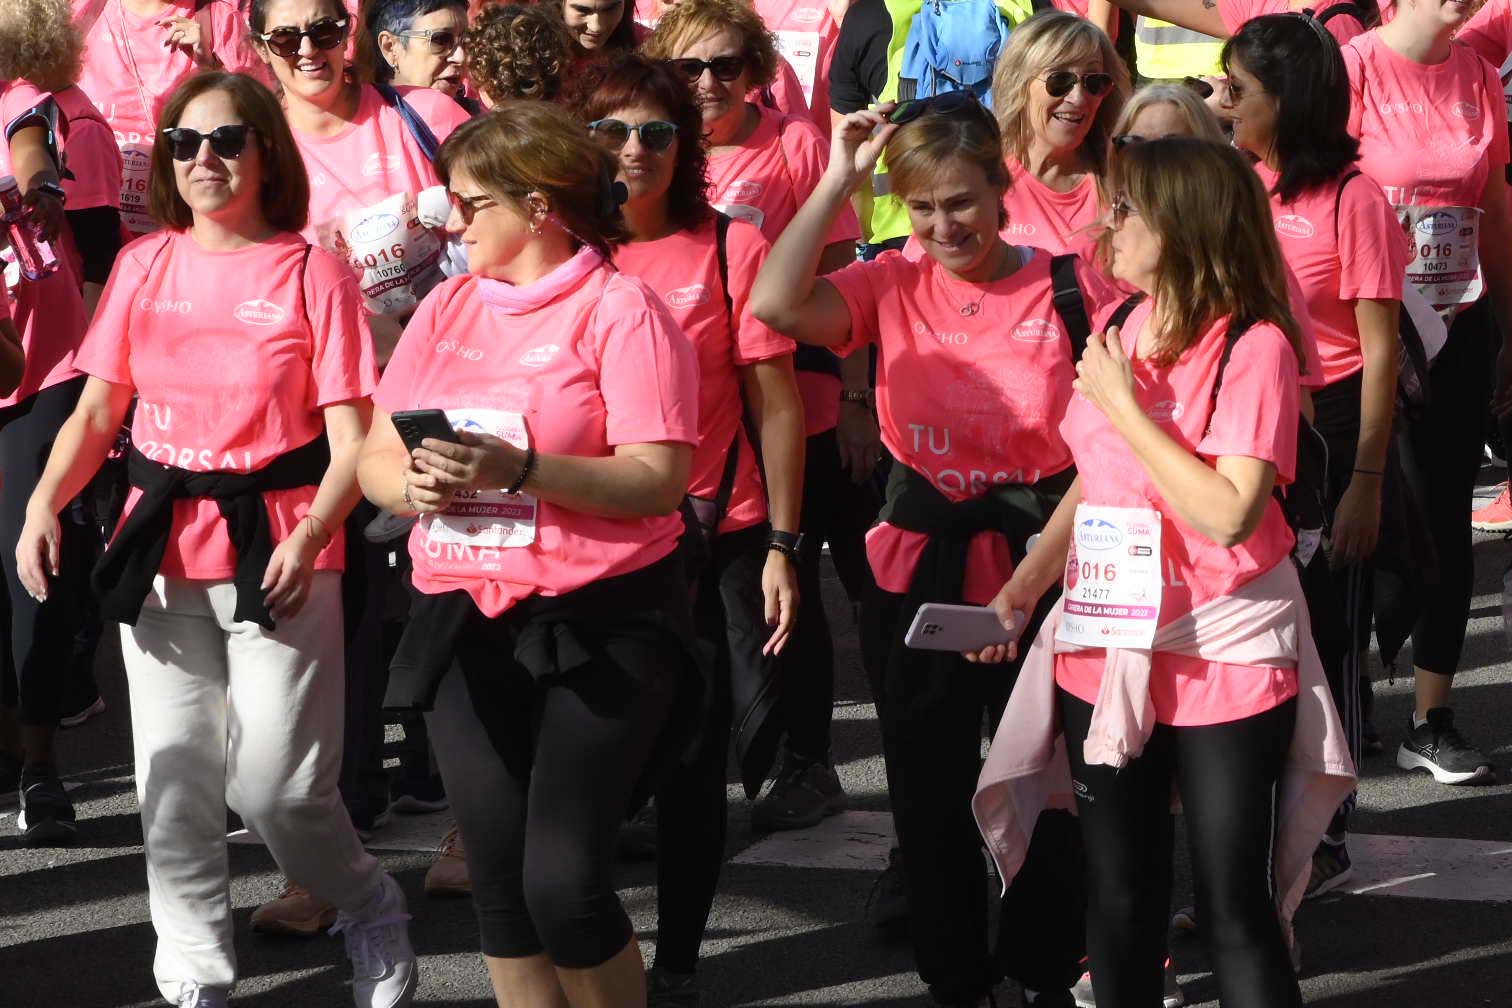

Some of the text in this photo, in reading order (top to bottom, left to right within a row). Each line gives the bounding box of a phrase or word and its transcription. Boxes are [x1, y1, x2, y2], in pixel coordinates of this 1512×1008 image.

[122, 178, 147, 192] 16
[1420, 243, 1452, 258] 016
[436, 340, 483, 361] OSHO
[908, 423, 951, 455] TU
[468, 506, 498, 515] MUJER
[1080, 529, 1120, 543] ASTURIANA
[1127, 527, 1152, 536] SUMA
[1081, 561, 1117, 582] 016
[1082, 587, 1111, 600] 21477
[1092, 605, 1103, 615] LA
[1103, 606, 1129, 616] MUJER
